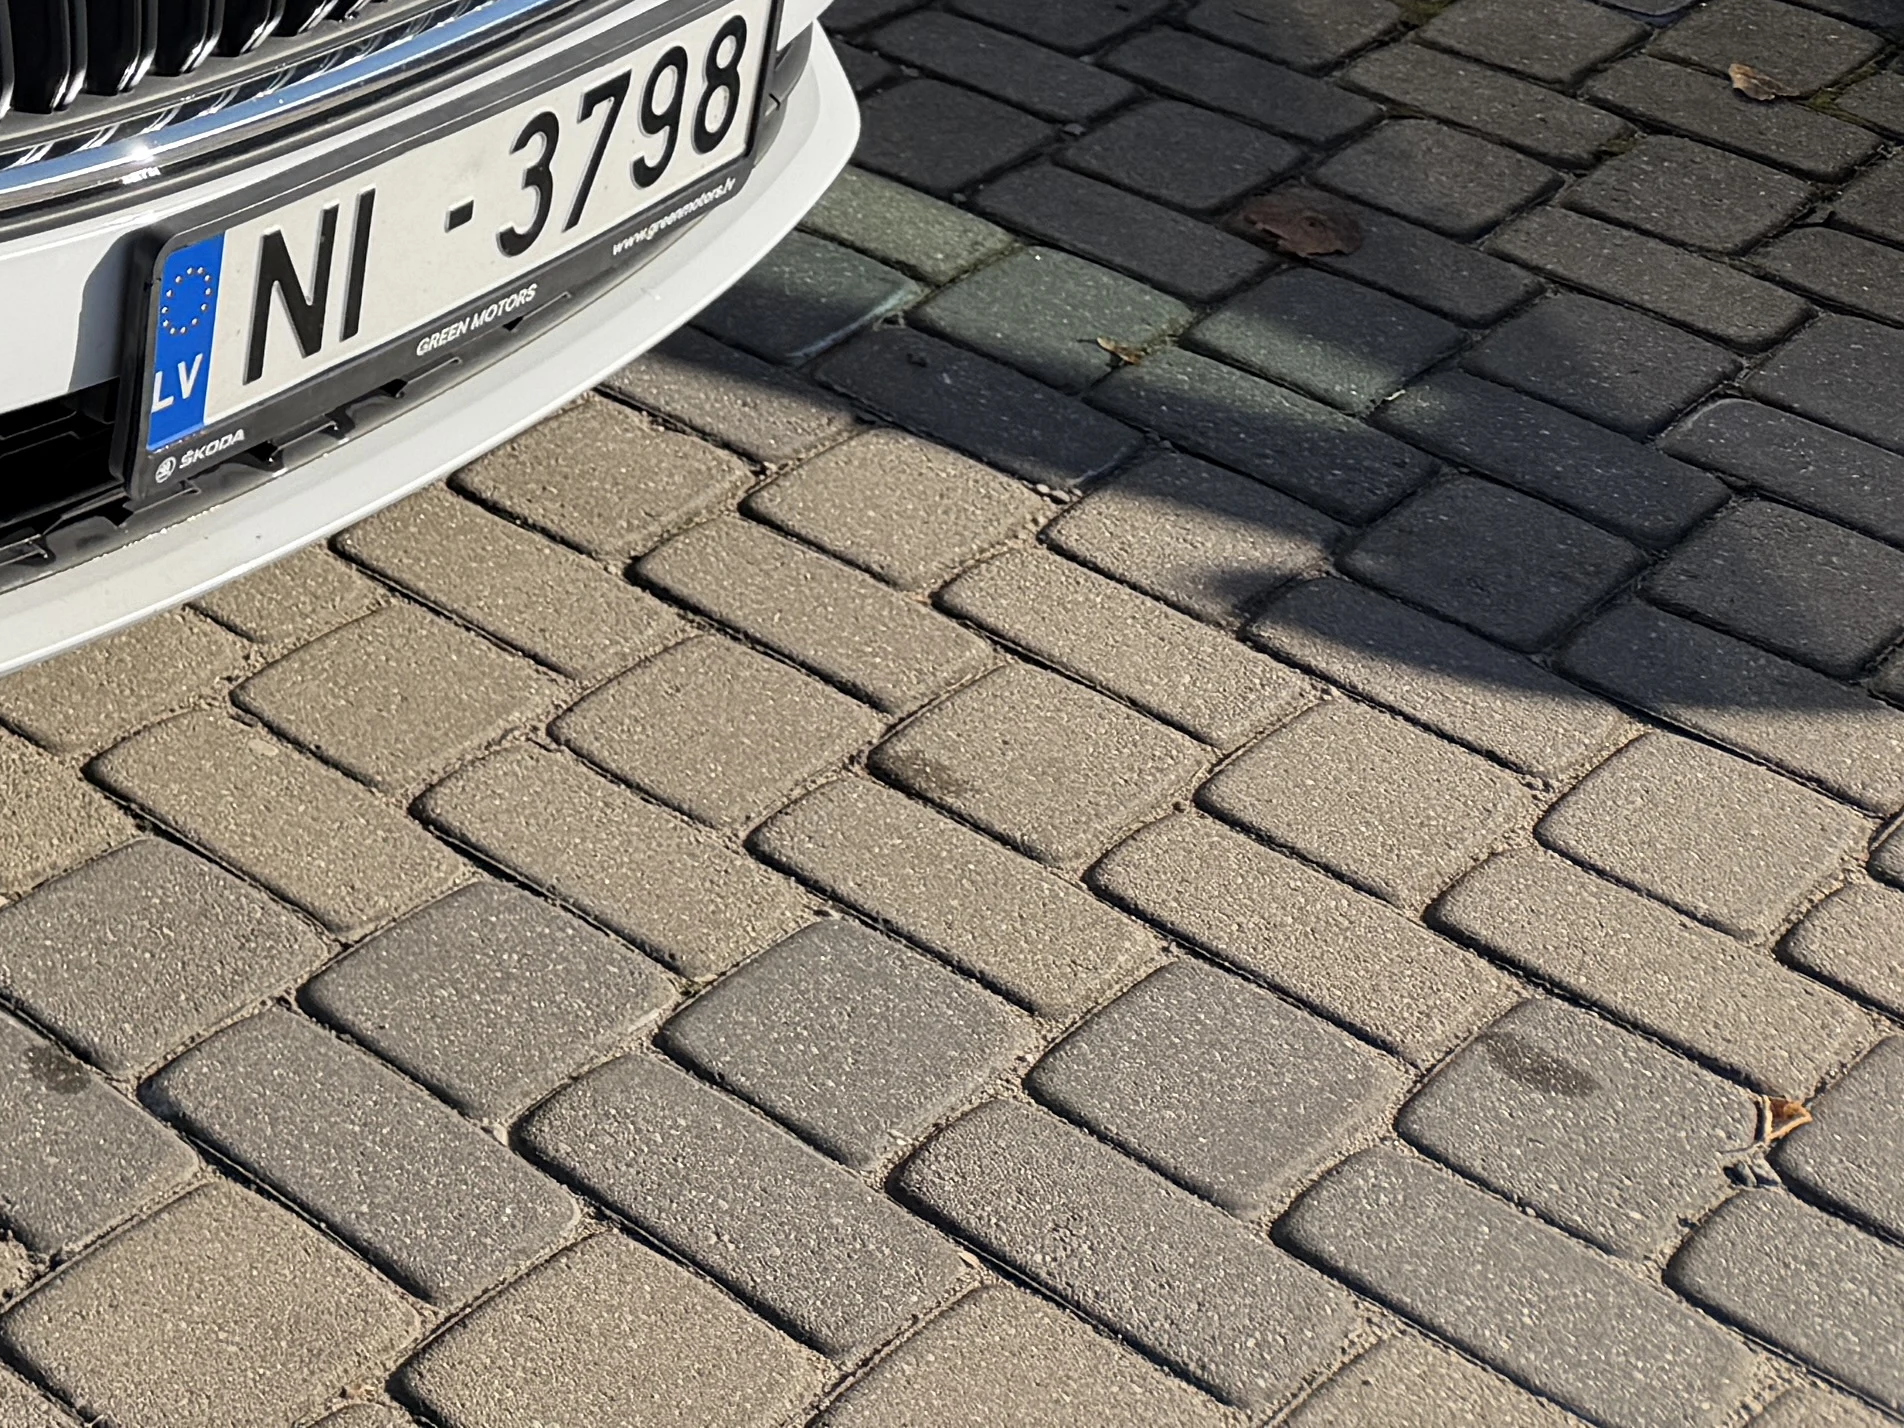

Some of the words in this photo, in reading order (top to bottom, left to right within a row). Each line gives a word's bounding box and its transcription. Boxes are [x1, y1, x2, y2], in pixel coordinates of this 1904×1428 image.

[612, 176, 736, 256] www.greenmotors.lv
[243, 186, 377, 386] NI
[416, 316, 471, 357] GREEN
[470, 282, 538, 331] MOTORS
[150, 352, 204, 414] LV
[179, 428, 246, 470] ŠKODA
